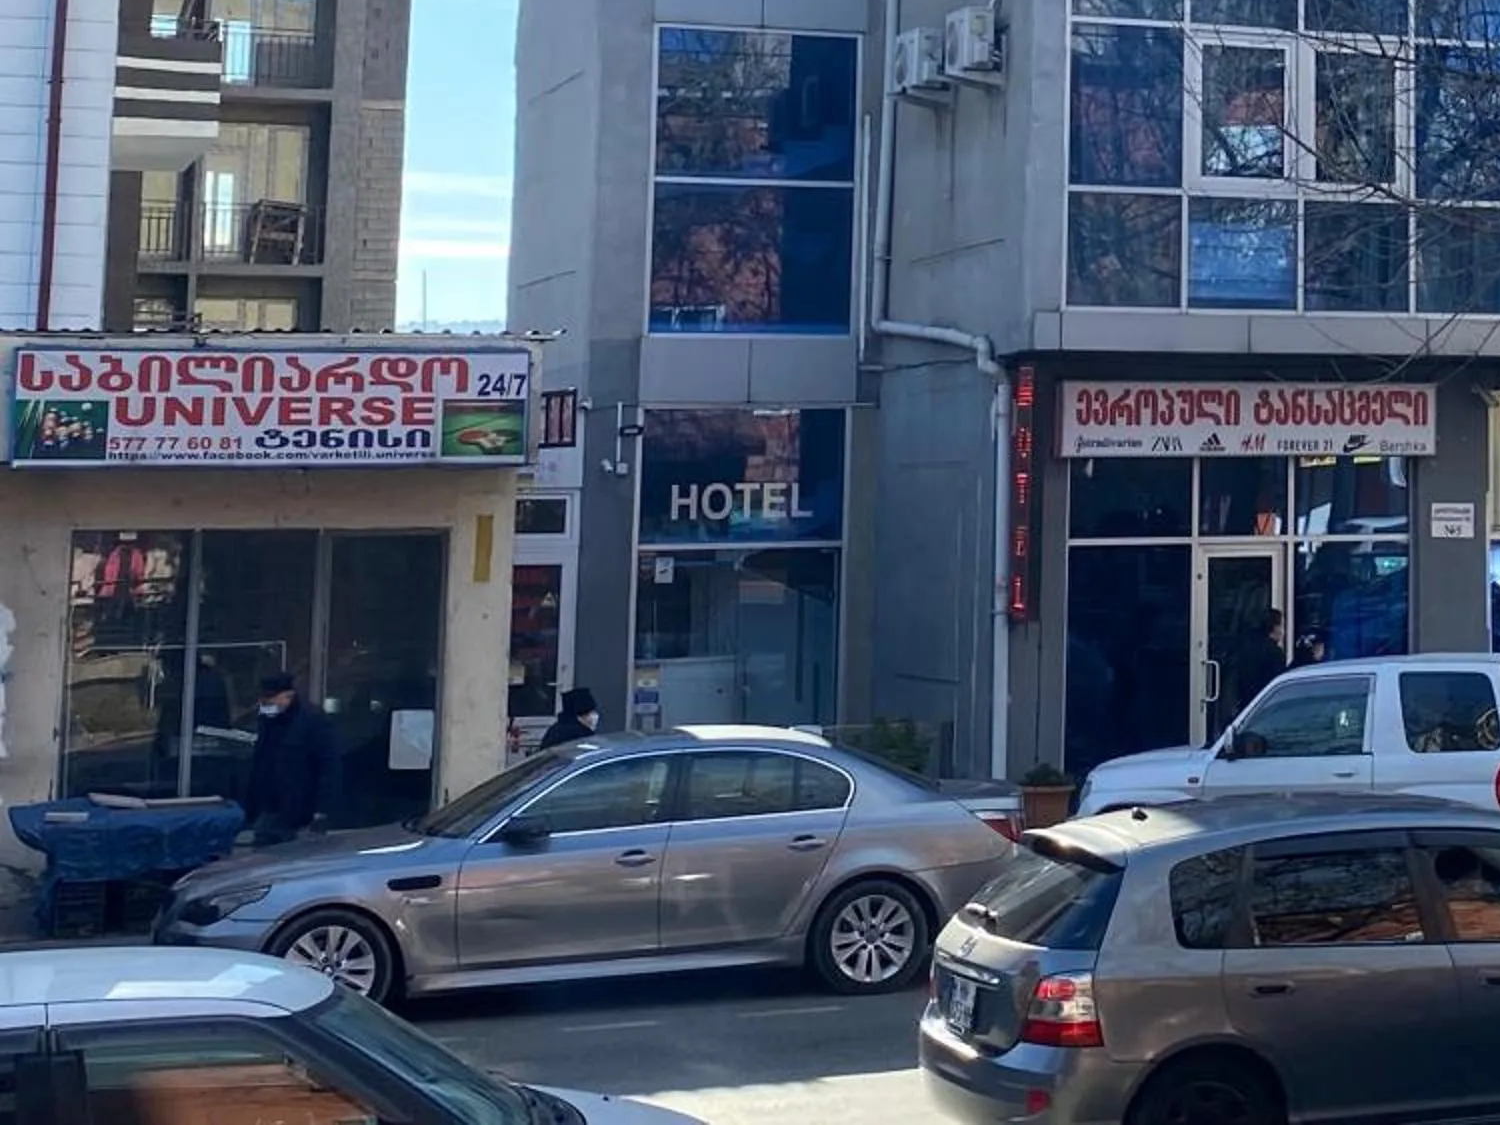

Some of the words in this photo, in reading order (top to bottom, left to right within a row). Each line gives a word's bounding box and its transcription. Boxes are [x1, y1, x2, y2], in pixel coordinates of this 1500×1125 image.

[19, 354, 469, 393] საბილიარდო
[477, 373, 527, 397] 24/7
[115, 396, 435, 426] UNIVERSE
[1075, 388, 1241, 426] ევროპული
[1253, 388, 1428, 426] ტანსაცმელი
[108, 437, 147, 450] 577
[154, 437, 180, 450] 77
[187, 437, 212, 450] 60
[219, 437, 242, 450] 81
[255, 428, 431, 449] ტენისი
[670, 482, 814, 520] HOTEL
